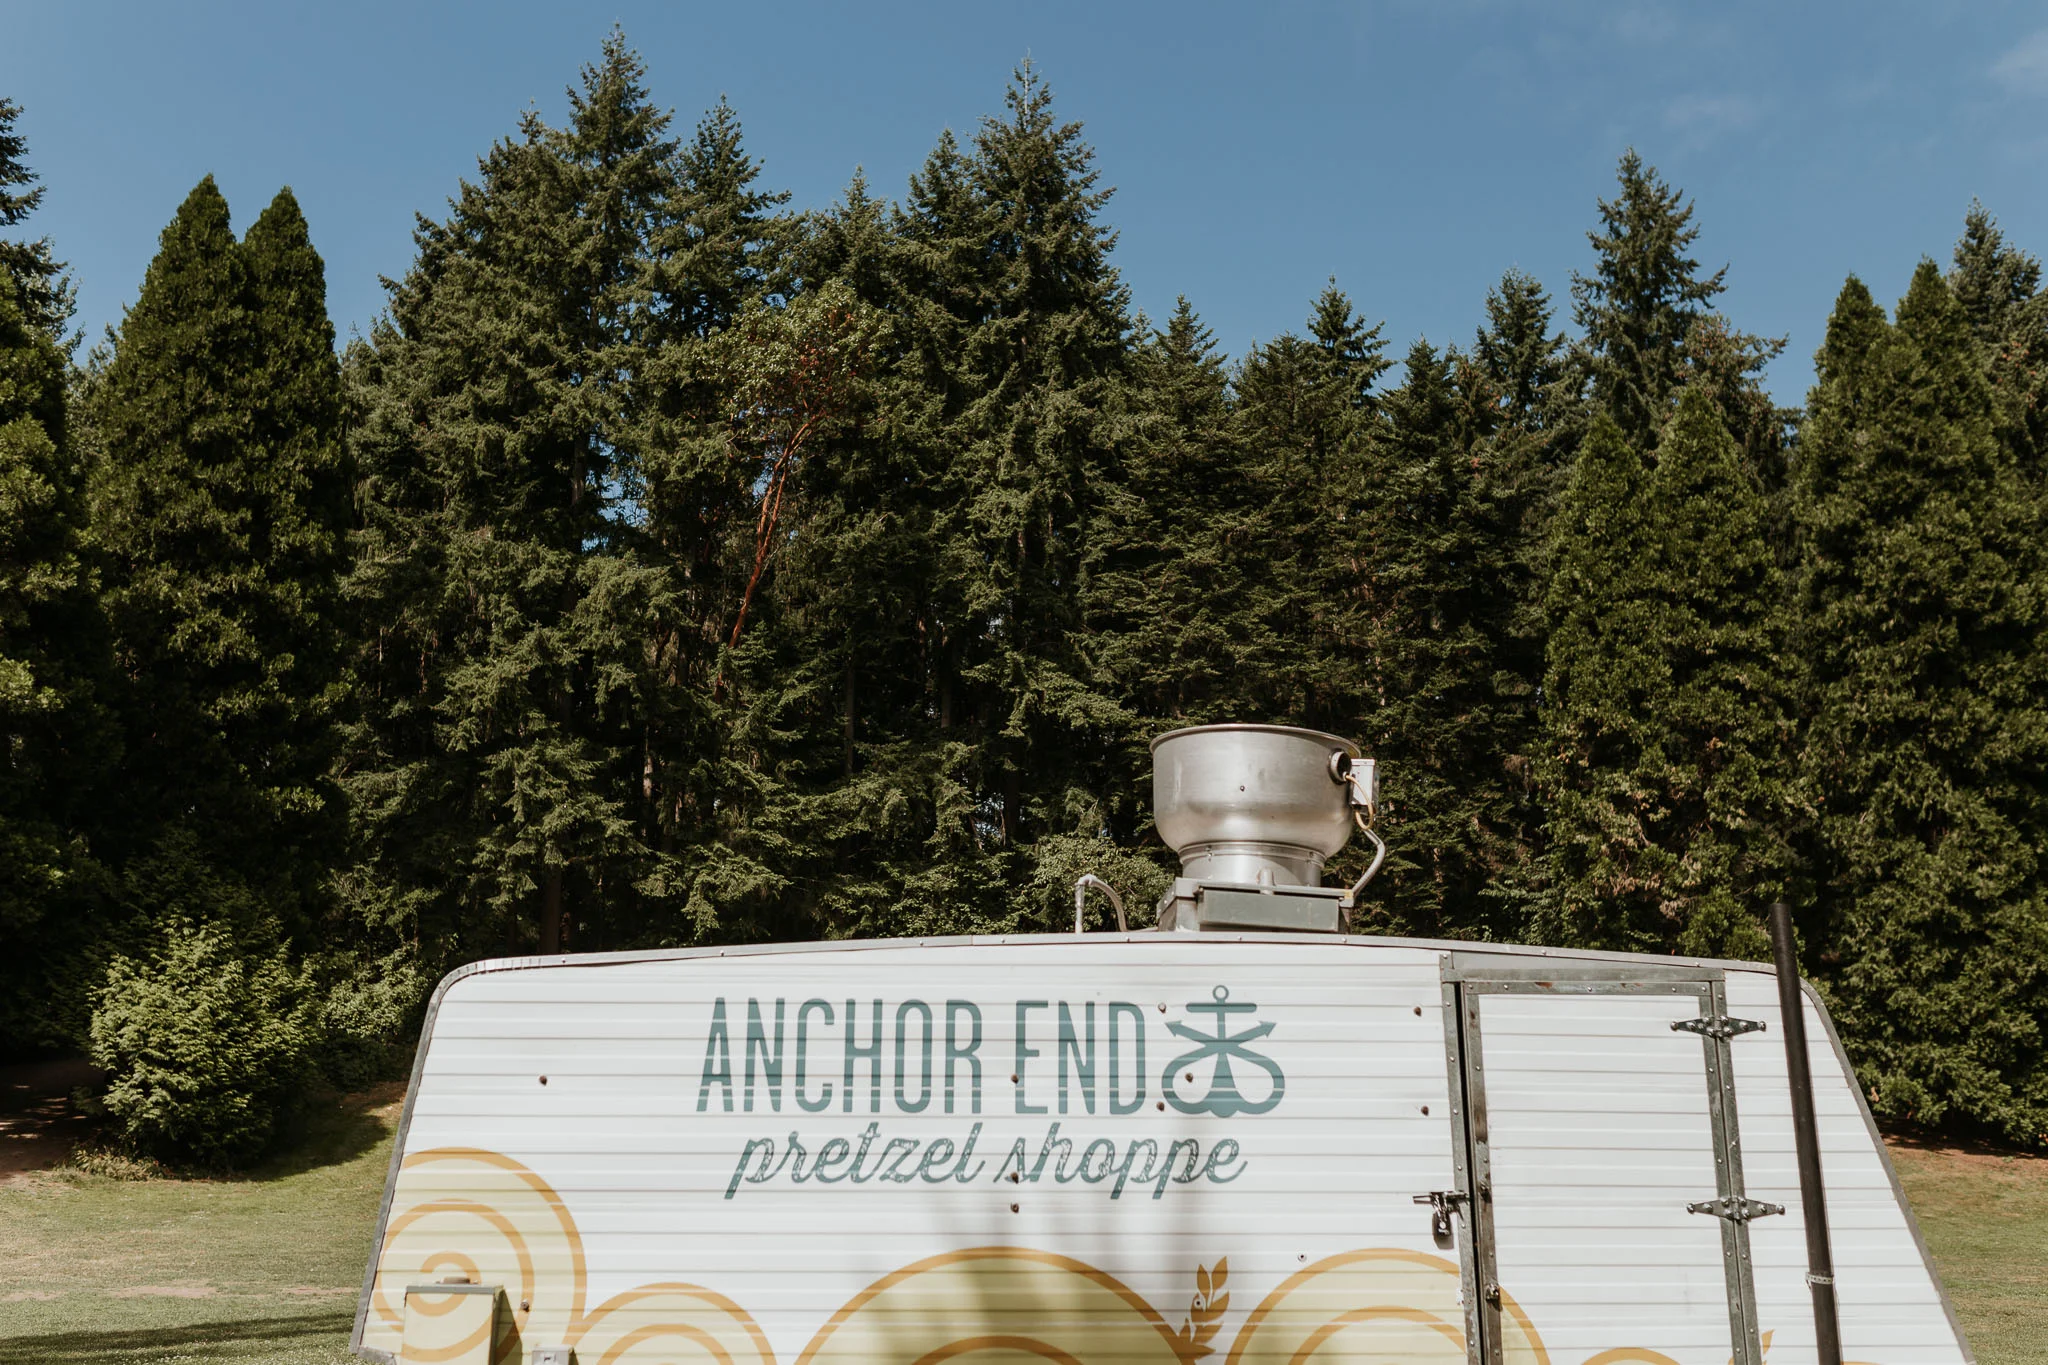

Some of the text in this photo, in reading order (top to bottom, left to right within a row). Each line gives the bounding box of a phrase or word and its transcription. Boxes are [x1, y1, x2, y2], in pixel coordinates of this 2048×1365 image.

[696, 997, 1146, 1114] ANCHOR END
[724, 1122, 1248, 1199] pretzel shoppe
